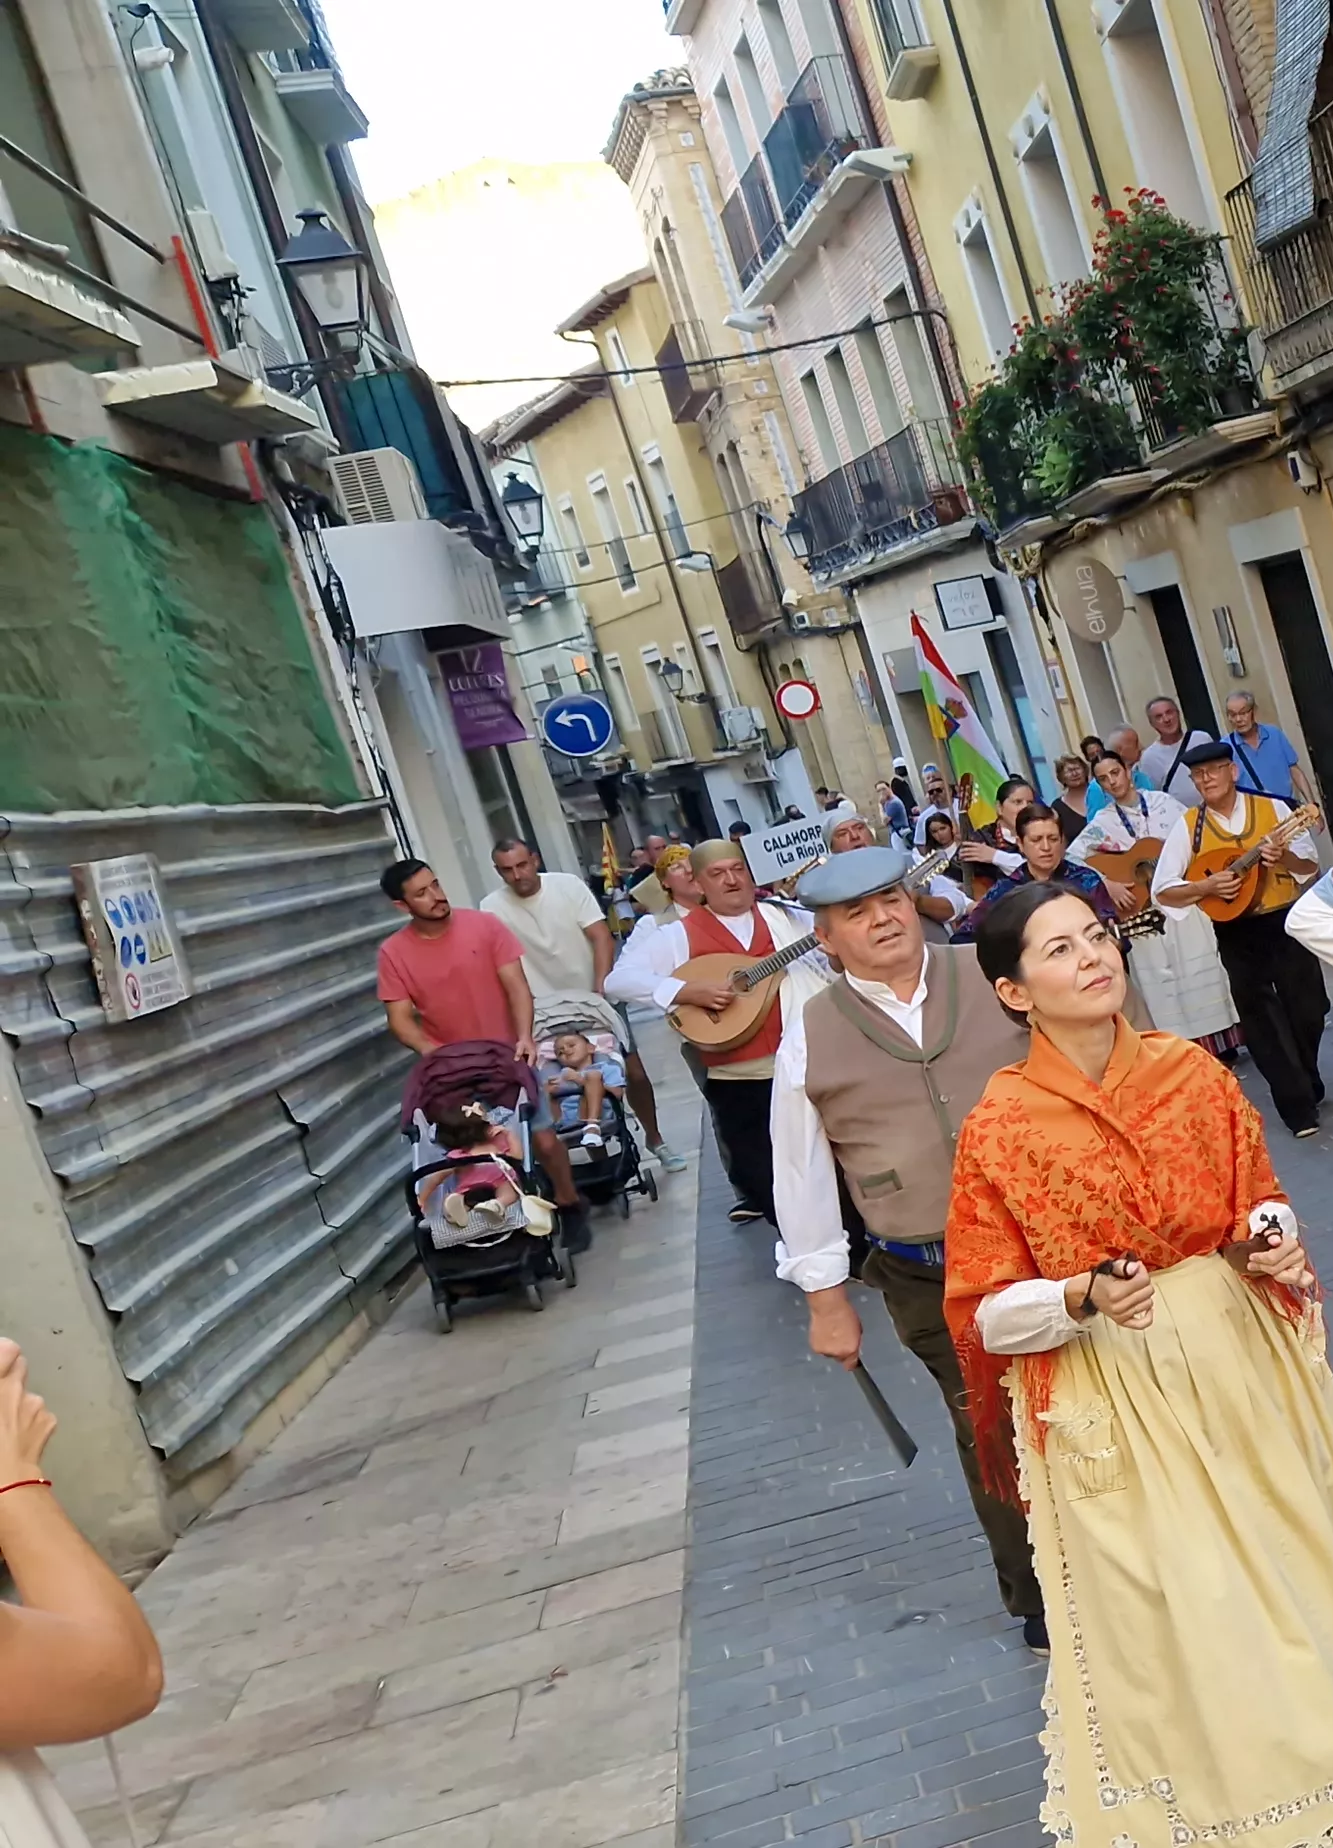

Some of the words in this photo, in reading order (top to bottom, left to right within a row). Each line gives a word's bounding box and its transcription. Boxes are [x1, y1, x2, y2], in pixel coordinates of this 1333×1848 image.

[763, 825, 823, 853] CALAHORR
[776, 851, 795, 868] (La
[796, 840, 829, 860] Rioja)
